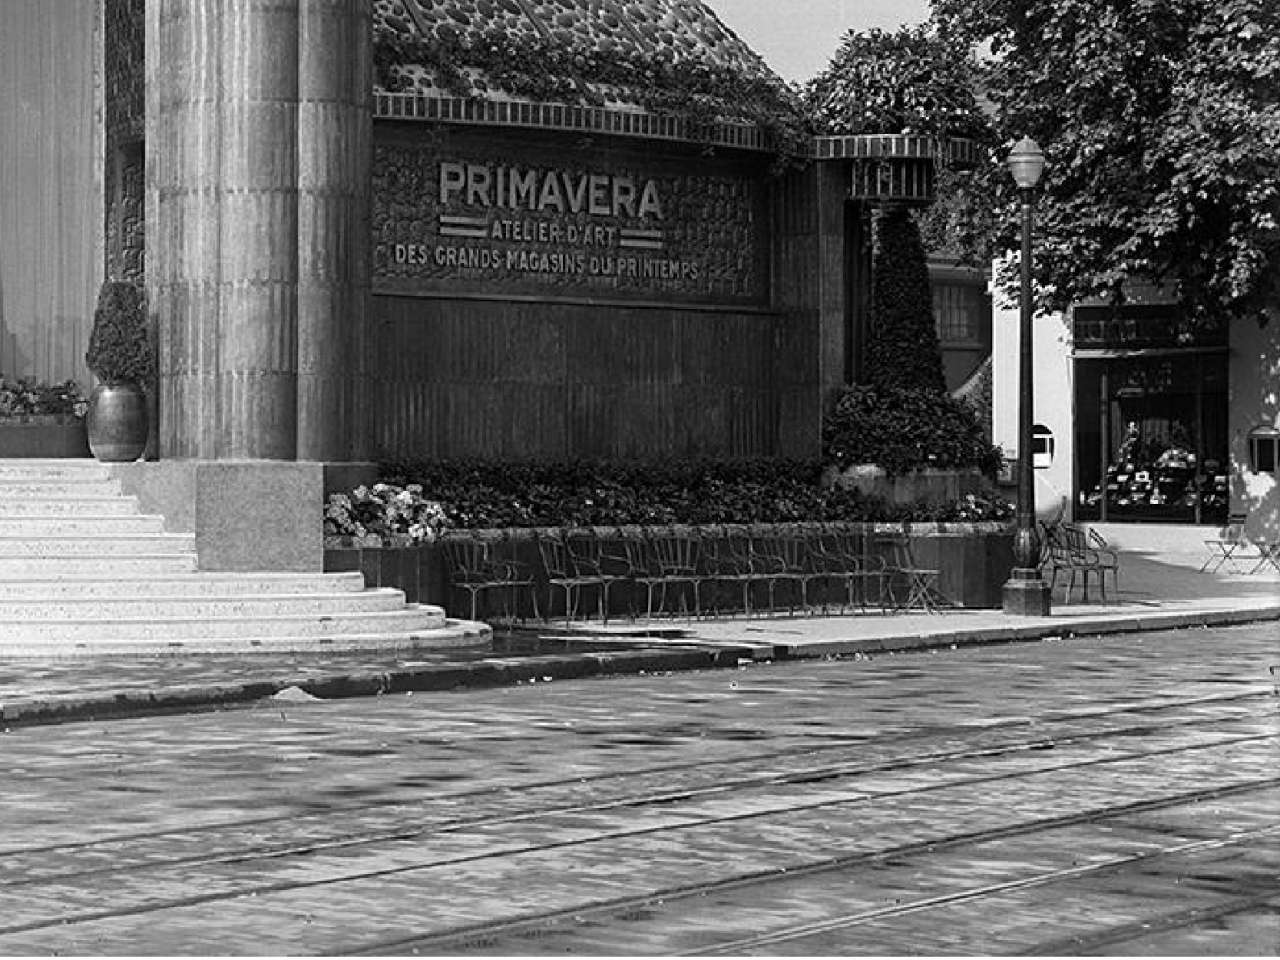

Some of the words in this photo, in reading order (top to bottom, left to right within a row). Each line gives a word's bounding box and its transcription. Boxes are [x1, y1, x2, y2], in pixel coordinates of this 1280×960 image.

[439, 162, 664, 219] PRIMAVERA
[492, 220, 562, 242] ATELIER
[567, 225, 616, 246] D'ART
[395, 243, 427, 265] DES
[435, 246, 499, 269] GRANDS
[506, 250, 584, 274] MAGASINS
[589, 256, 613, 275] DU
[617, 257, 699, 280] PRINTEMPS
